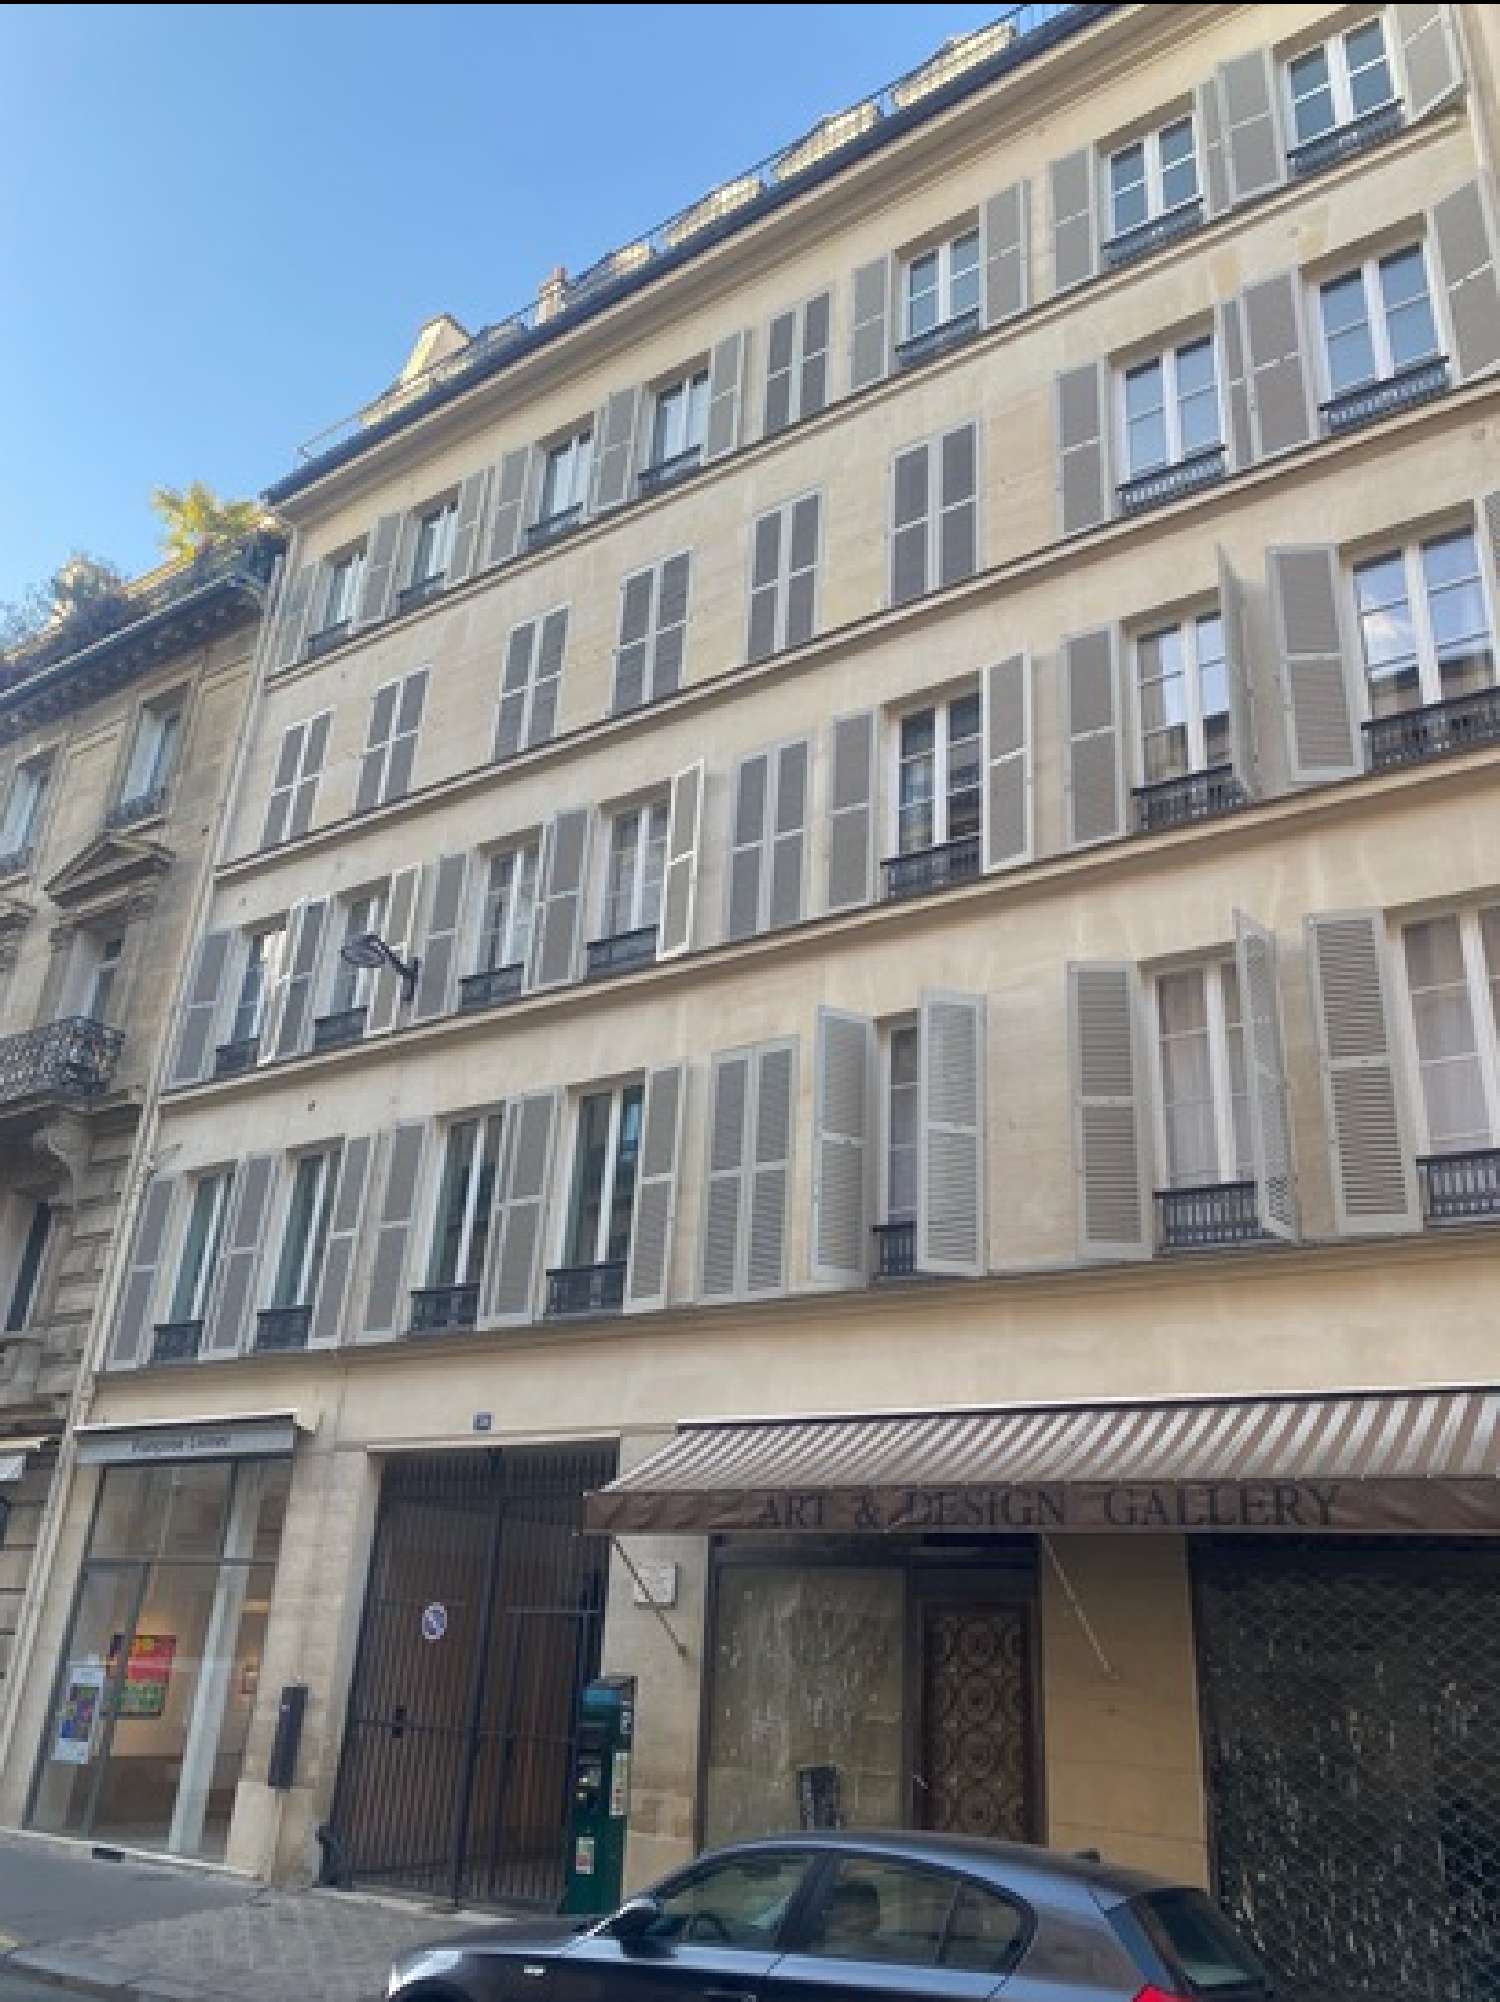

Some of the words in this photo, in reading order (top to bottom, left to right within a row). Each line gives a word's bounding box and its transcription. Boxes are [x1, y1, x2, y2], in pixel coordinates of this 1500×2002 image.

[757, 1493, 827, 1527] ART
[855, 1491, 881, 1528] &
[907, 1490, 1065, 1526] DESIGN
[1104, 1485, 1340, 1526] GALLERY
